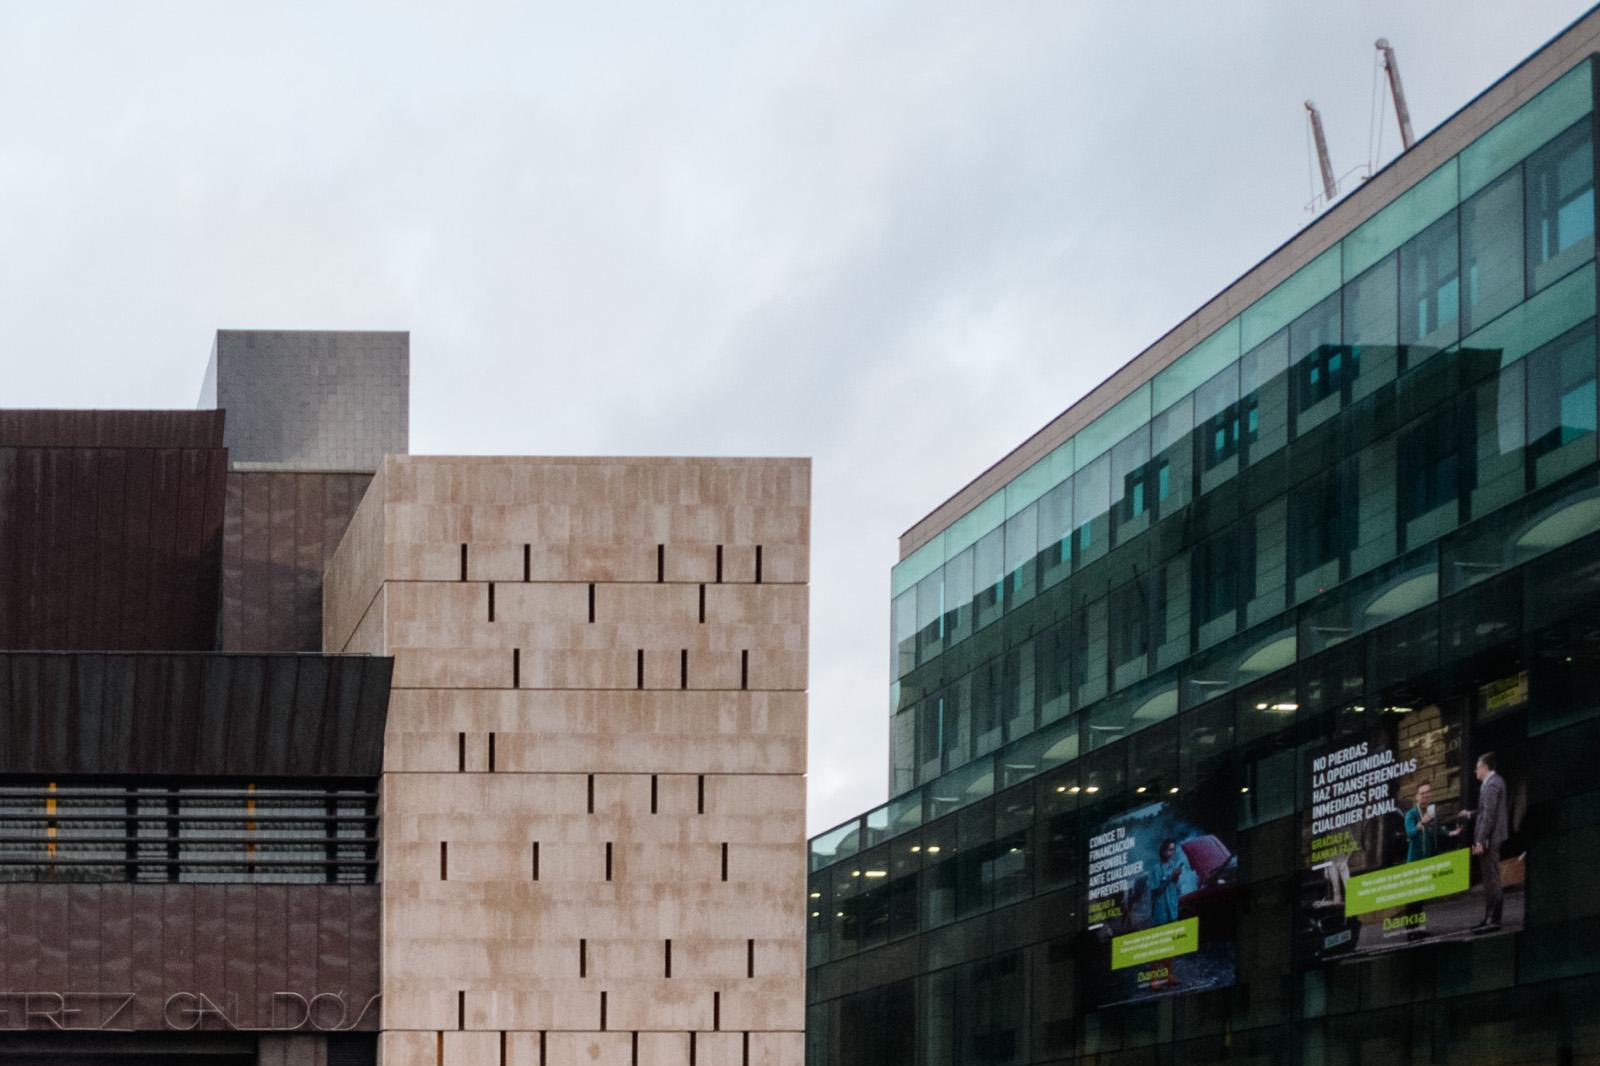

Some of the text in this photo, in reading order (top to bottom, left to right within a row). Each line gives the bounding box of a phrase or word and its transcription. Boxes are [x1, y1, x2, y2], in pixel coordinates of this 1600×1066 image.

[1313, 742, 1368, 772] NO PIERDAS
[1313, 750, 1395, 788] LA OPORTUNIDAD.
[1313, 758, 1418, 803] HAZ TRANSFERENCIAS
[1312, 784, 1389, 819] INMEDIATAS POR
[1312, 798, 1398, 835] CUALQUIER CANAL
[1089, 827, 1125, 849] CONOCE TU
[1106, 861, 1144, 881] CUALQUIER
[164, 989, 382, 1031] GALDÓS
